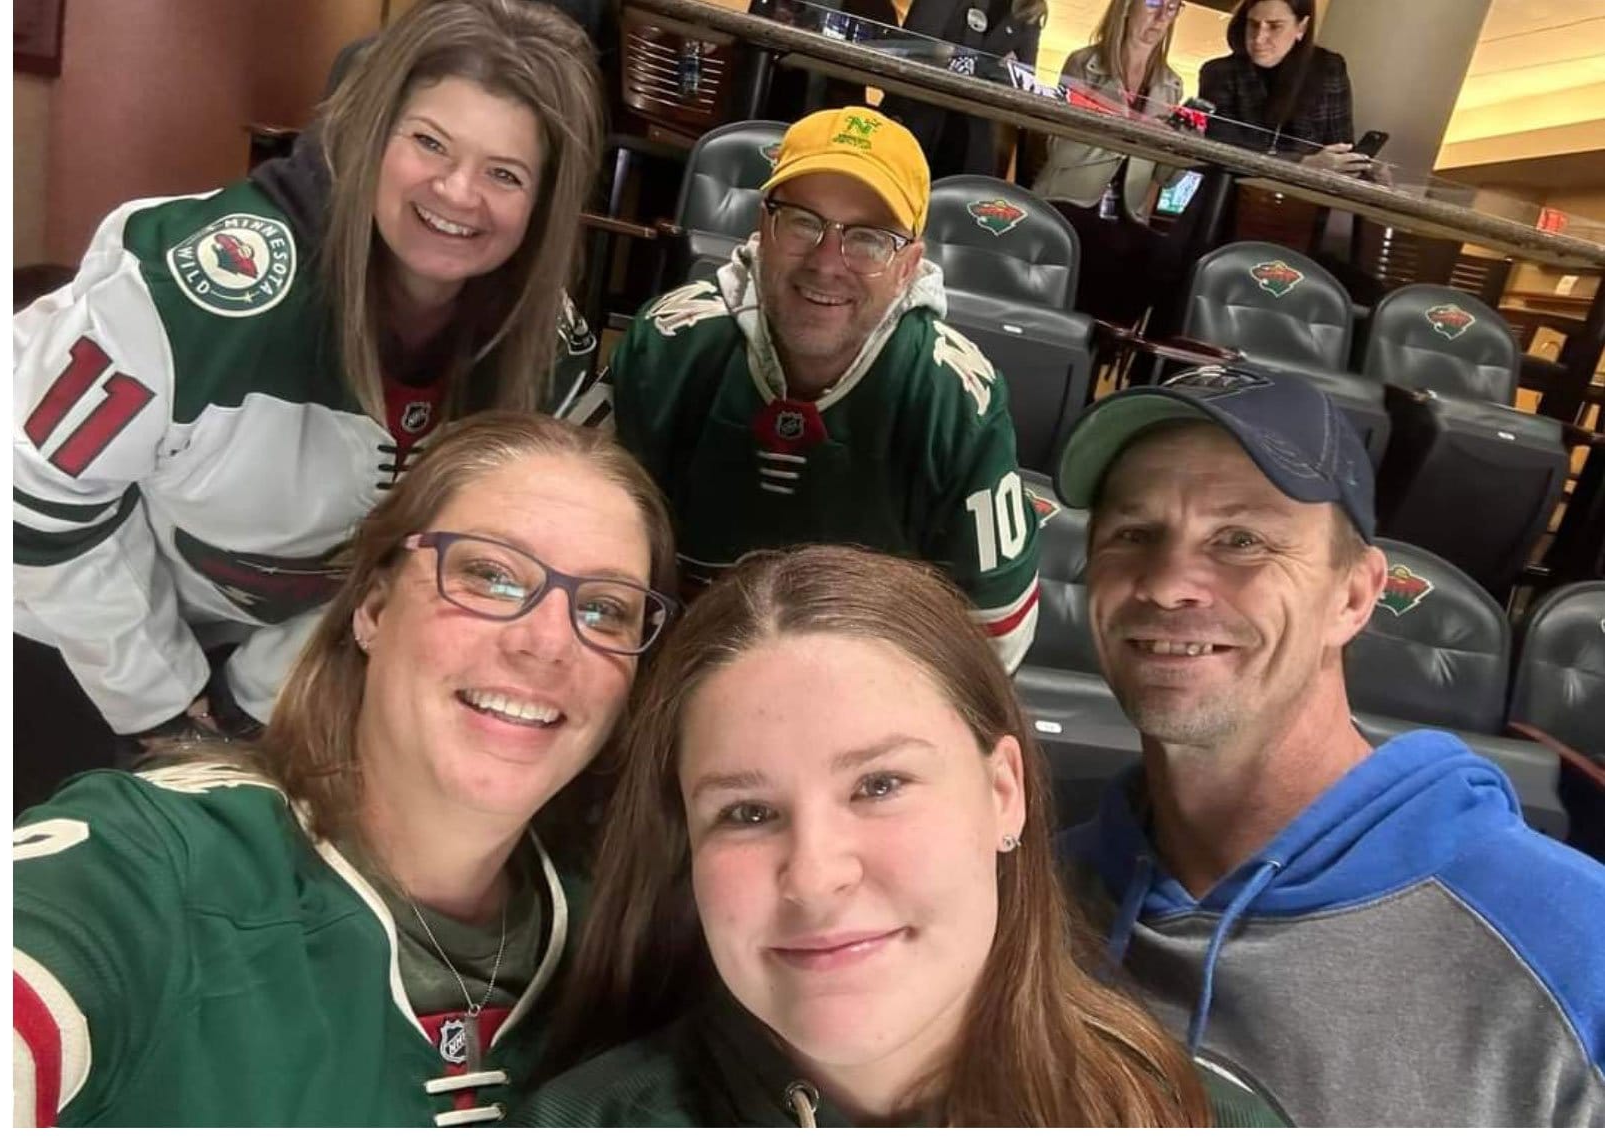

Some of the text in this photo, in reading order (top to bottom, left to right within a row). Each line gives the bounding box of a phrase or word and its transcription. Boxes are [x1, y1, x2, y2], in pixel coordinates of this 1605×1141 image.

[176, 246, 211, 295] WILD
[224, 217, 288, 297] MINNESOTA
[23, 335, 157, 479] 11
[965, 471, 1028, 573] 10
